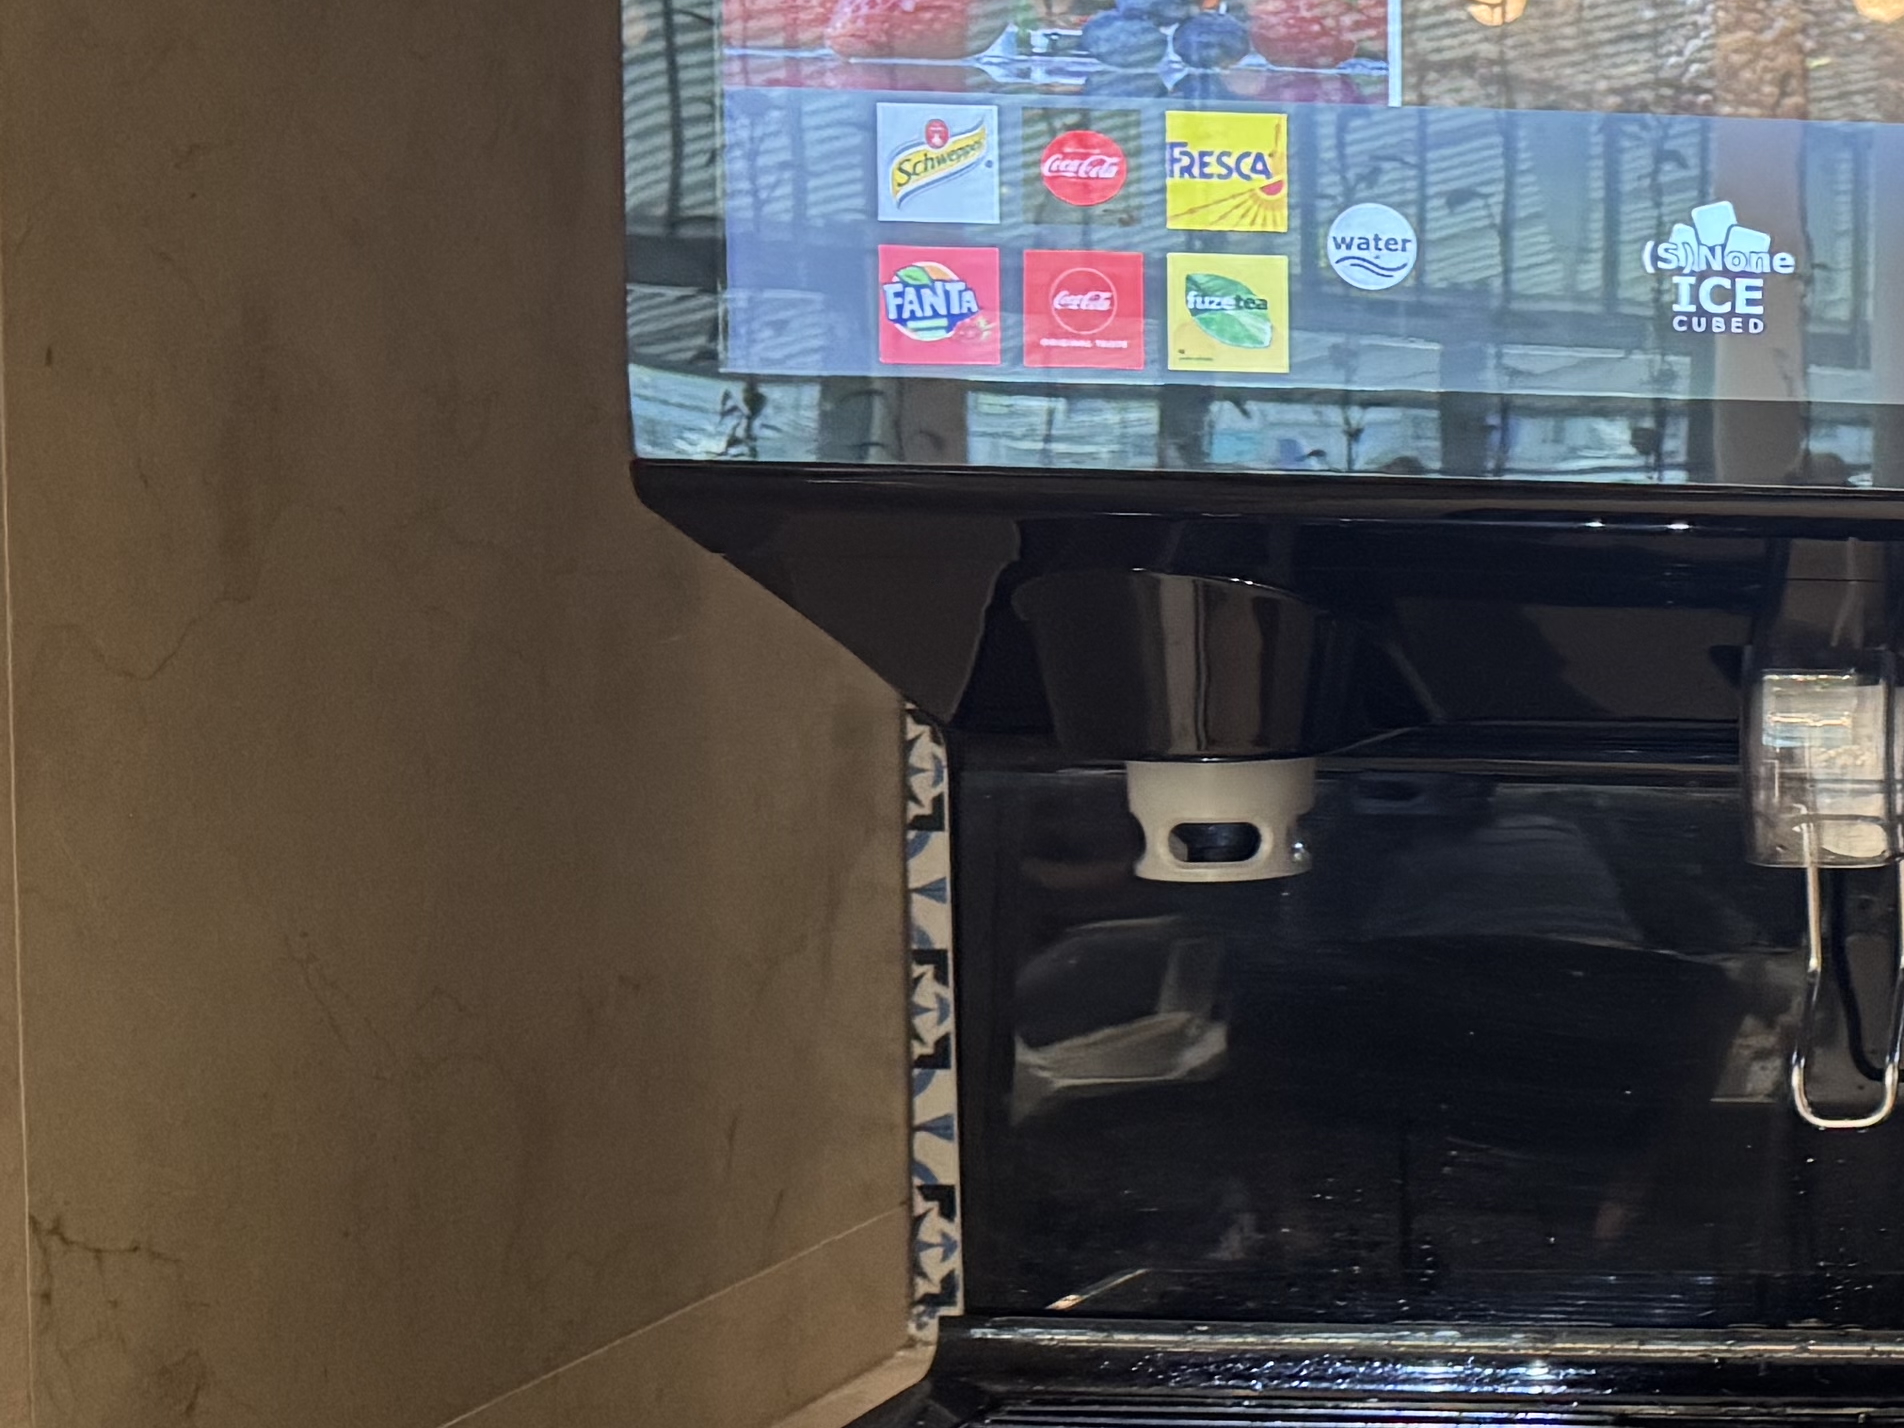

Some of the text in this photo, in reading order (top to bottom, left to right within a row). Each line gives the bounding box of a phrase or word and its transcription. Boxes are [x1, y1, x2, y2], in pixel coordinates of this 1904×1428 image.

[1166, 141, 1274, 181] FRESCA
[1332, 233, 1412, 253] water
[882, 280, 979, 321] FANTA
[1672, 275, 1764, 315] ICE
[1672, 315, 1764, 334] CUBED
